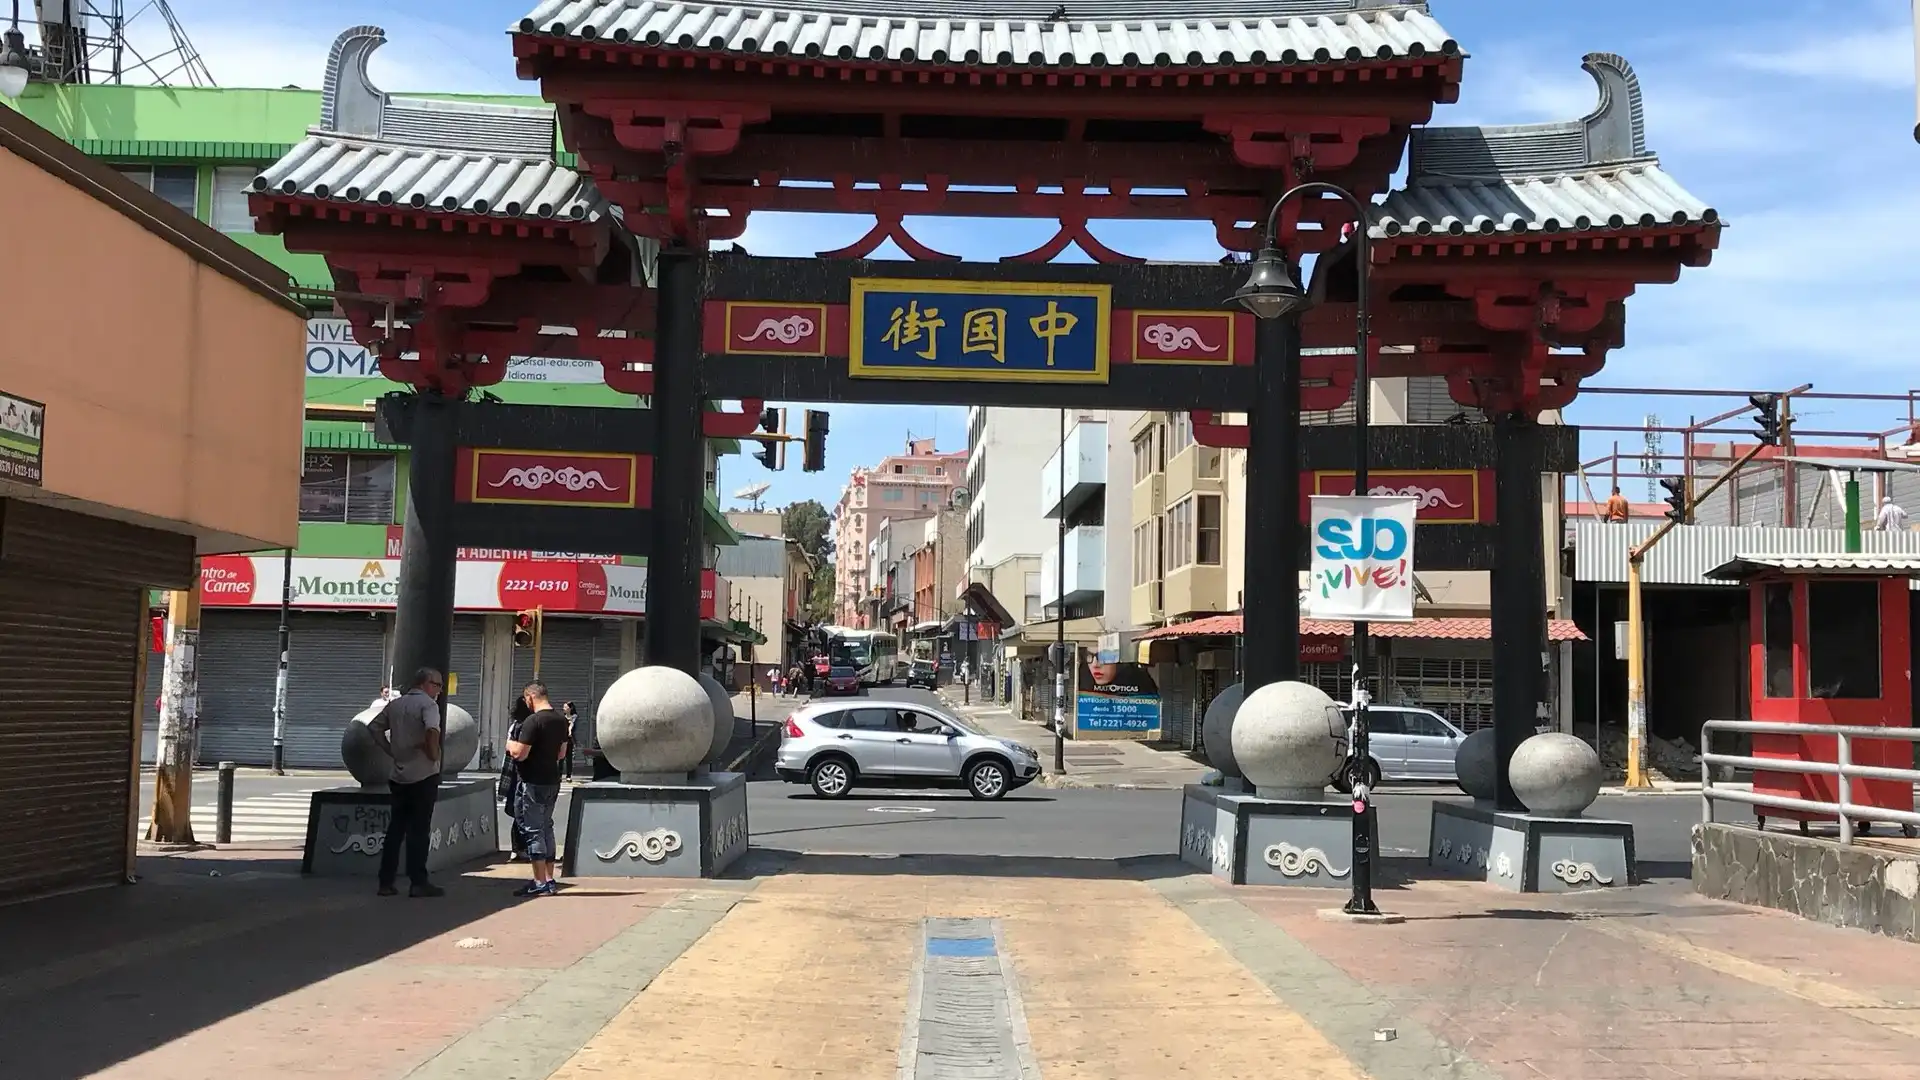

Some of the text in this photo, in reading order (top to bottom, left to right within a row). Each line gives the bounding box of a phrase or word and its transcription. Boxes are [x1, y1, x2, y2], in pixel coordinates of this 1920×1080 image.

[306, 455, 333, 467] 中文
[1316, 518, 1407, 561] SJO
[227, 571, 237, 579] de
[205, 579, 250, 593] Carnes
[505, 579, 569, 591] 2221-0310
[578, 581, 595, 589] Centro
[586, 588, 606, 596] Carnes
[610, 585, 647, 599] Mont
[1300, 644, 1338, 654] Josefina
[1089, 718, 1147, 728] Tel 2221-4926
